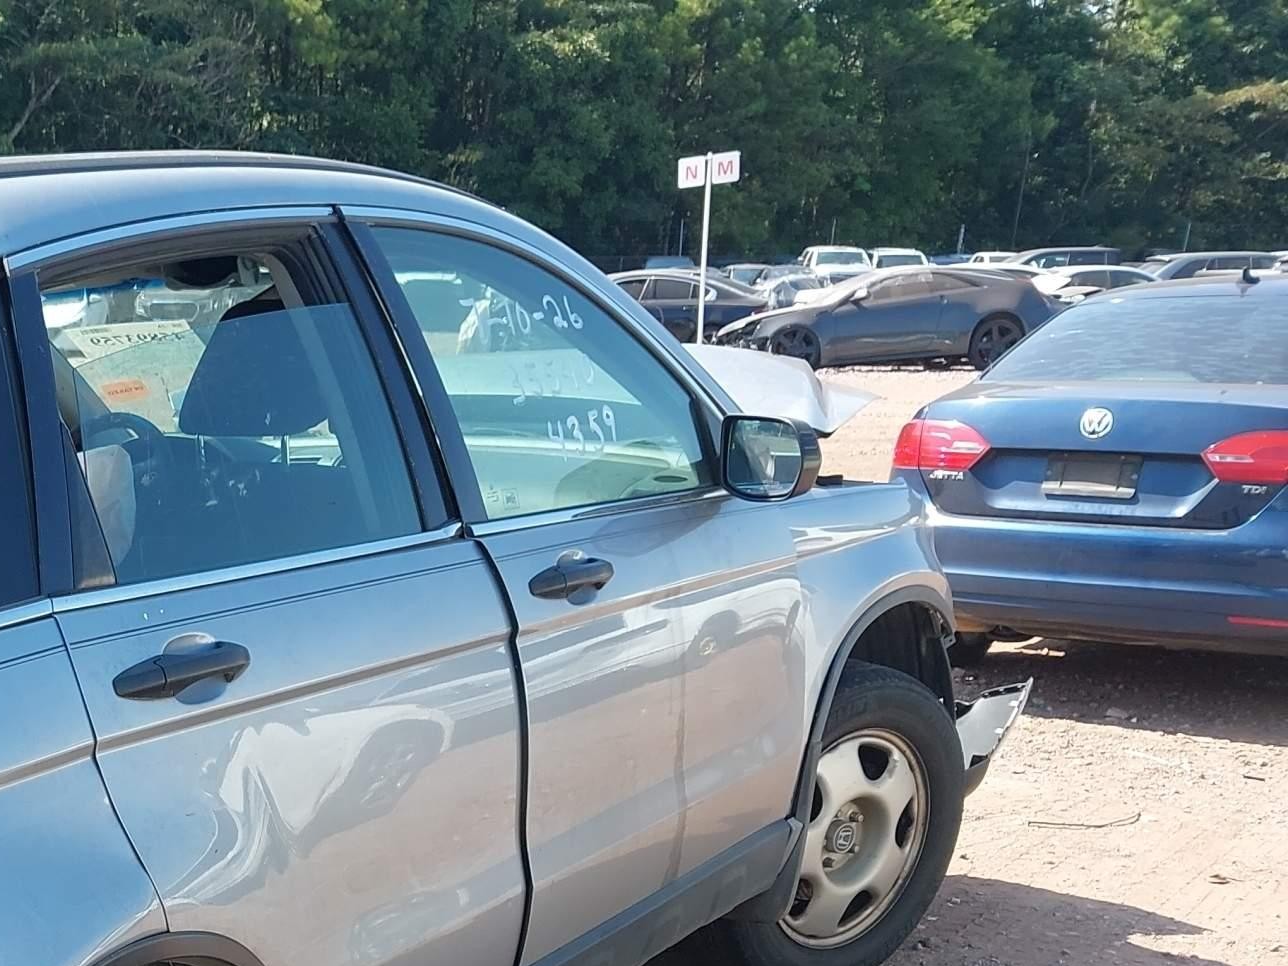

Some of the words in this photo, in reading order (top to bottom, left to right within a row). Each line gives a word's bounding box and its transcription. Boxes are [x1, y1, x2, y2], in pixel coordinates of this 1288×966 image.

[686, 165, 698, 180] N
[717, 160, 734, 177] M
[547, 404, 617, 462] 4359
[1241, 484, 1268, 495] TDI
